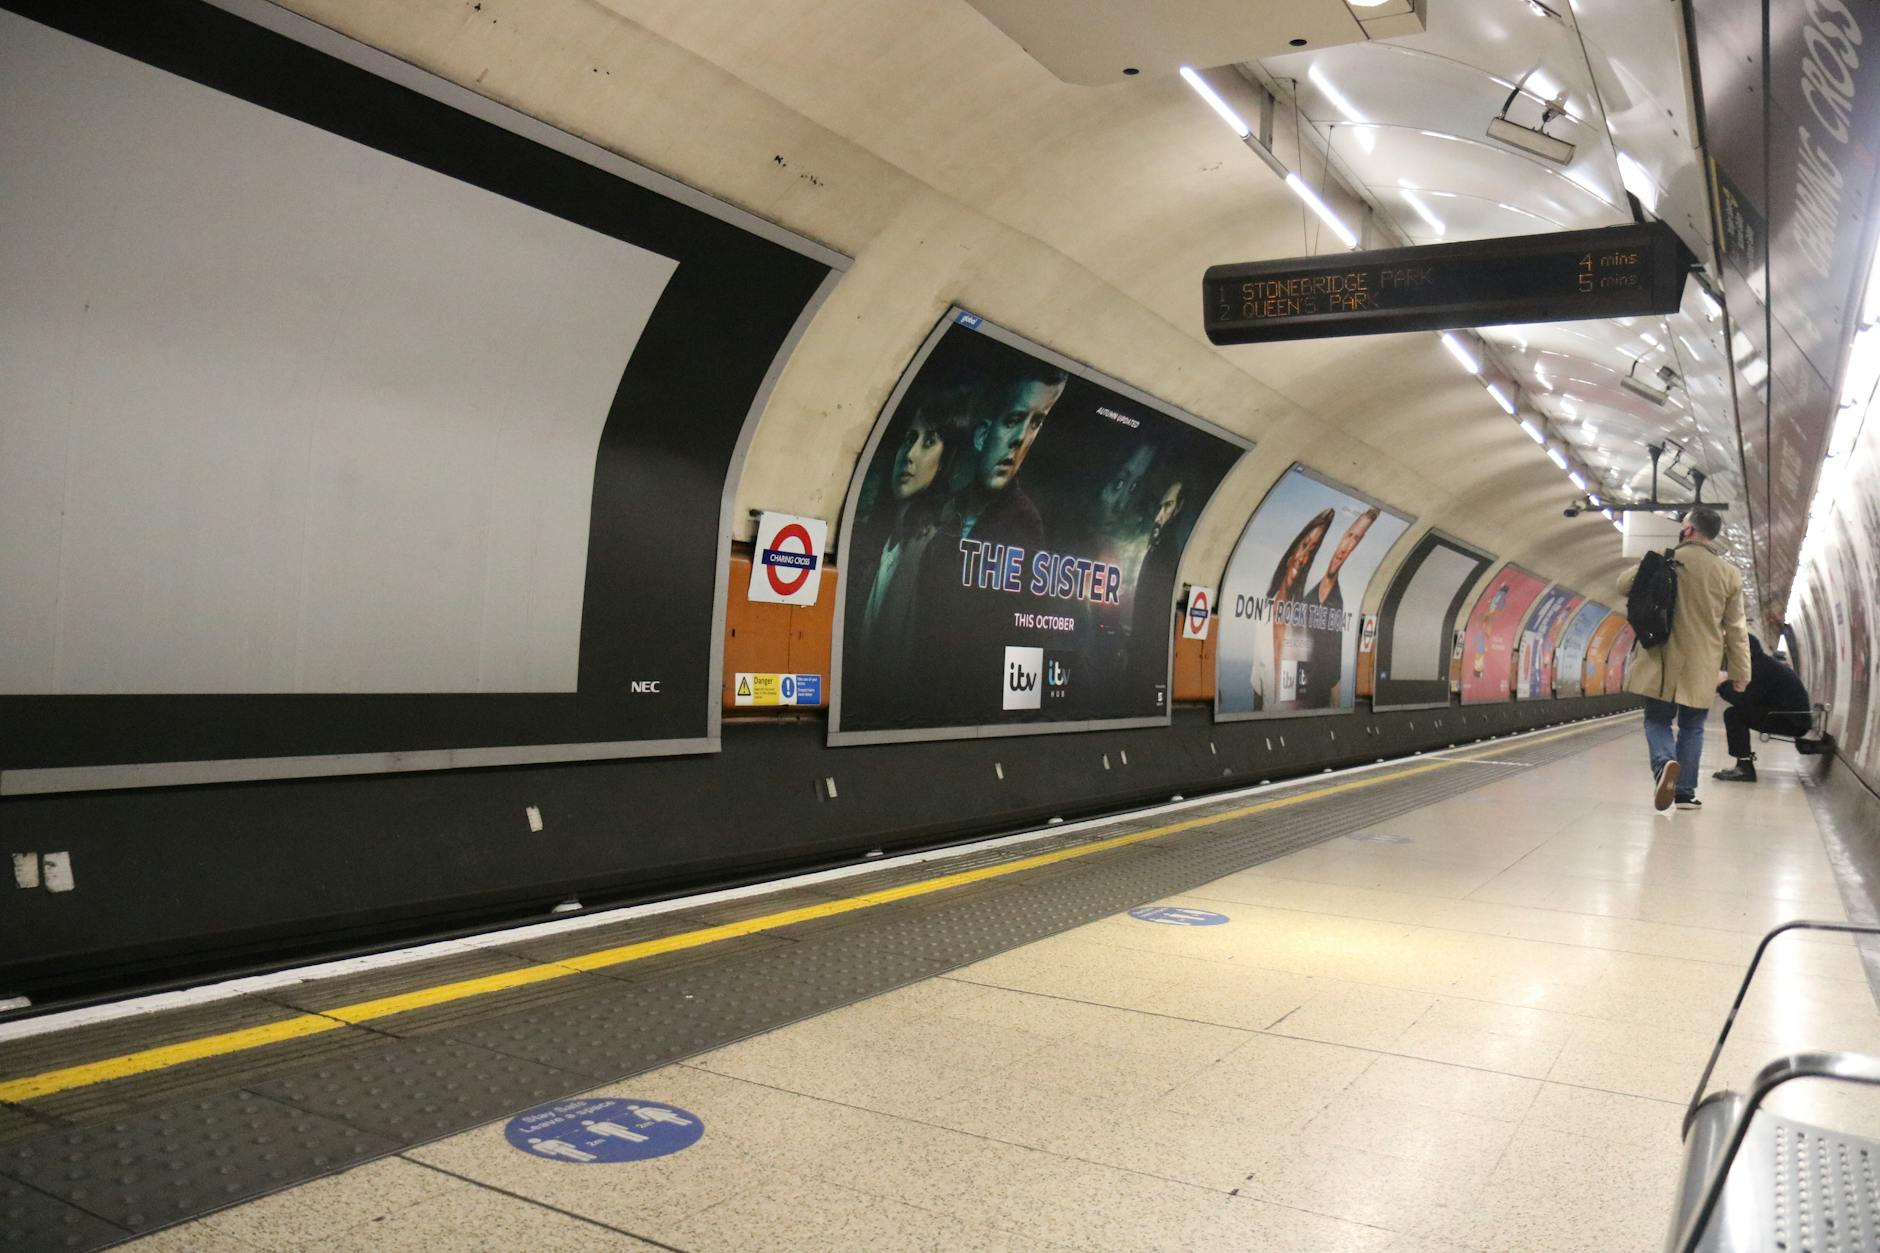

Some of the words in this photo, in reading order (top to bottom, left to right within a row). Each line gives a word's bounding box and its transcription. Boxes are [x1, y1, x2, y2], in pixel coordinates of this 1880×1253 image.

[1801, 0, 1863, 144] CROSS
[1793, 126, 1844, 278] CHARING
[1242, 273, 1368, 301] STONEBRIDGE
[1381, 267, 1434, 289] PARK
[1579, 252, 1593, 271] 4
[1600, 251, 1638, 267] mins
[1219, 304, 1230, 321] 2
[1242, 296, 1318, 319] QUEEN'S
[1330, 291, 1379, 312] PARK
[1578, 273, 1593, 292] 5
[1600, 273, 1638, 288] mins
[770, 553, 794, 565] CHARING
[794, 556, 811, 566] CROSS
[960, 538, 1024, 593] THE
[1030, 550, 1121, 606] SISTER
[1014, 612, 1034, 629] THIS
[1035, 613, 1075, 632] OCTOBER
[1235, 593, 1274, 622] DON'T
[1275, 600, 1308, 628] ROCK
[1307, 604, 1328, 630] THE
[1327, 608, 1353, 632] BOAT
[631, 680, 660, 693] NEC
[753, 676, 773, 686] Danger
[1009, 661, 1037, 692] itv
[1048, 659, 1071, 686] itv
[518, 1117, 566, 1133] Leave
[575, 1100, 616, 1115] space
[521, 1111, 556, 1123] Stay
